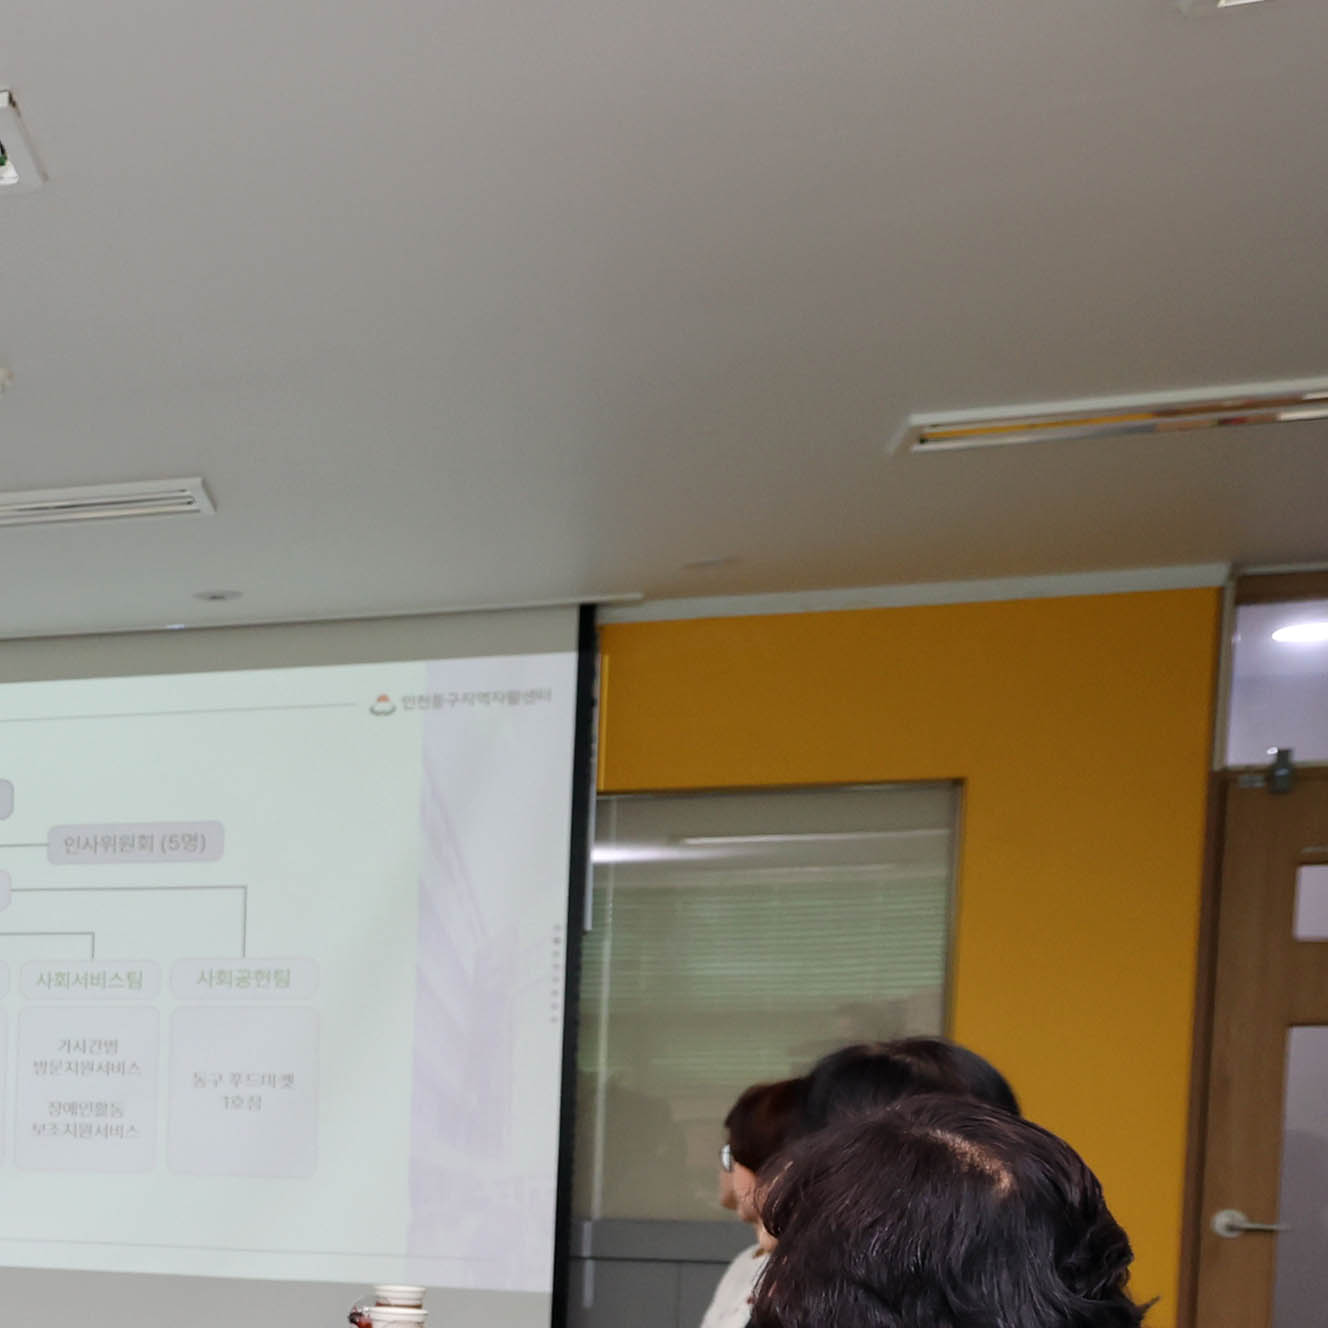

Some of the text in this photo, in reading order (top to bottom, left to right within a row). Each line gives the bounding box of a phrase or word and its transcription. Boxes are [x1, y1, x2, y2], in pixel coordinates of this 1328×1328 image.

[62, 832, 207, 857] 인사위원회 (5명)
[34, 969, 144, 992] 사회서비스팀
[195, 967, 292, 990] 사회공헌팀
